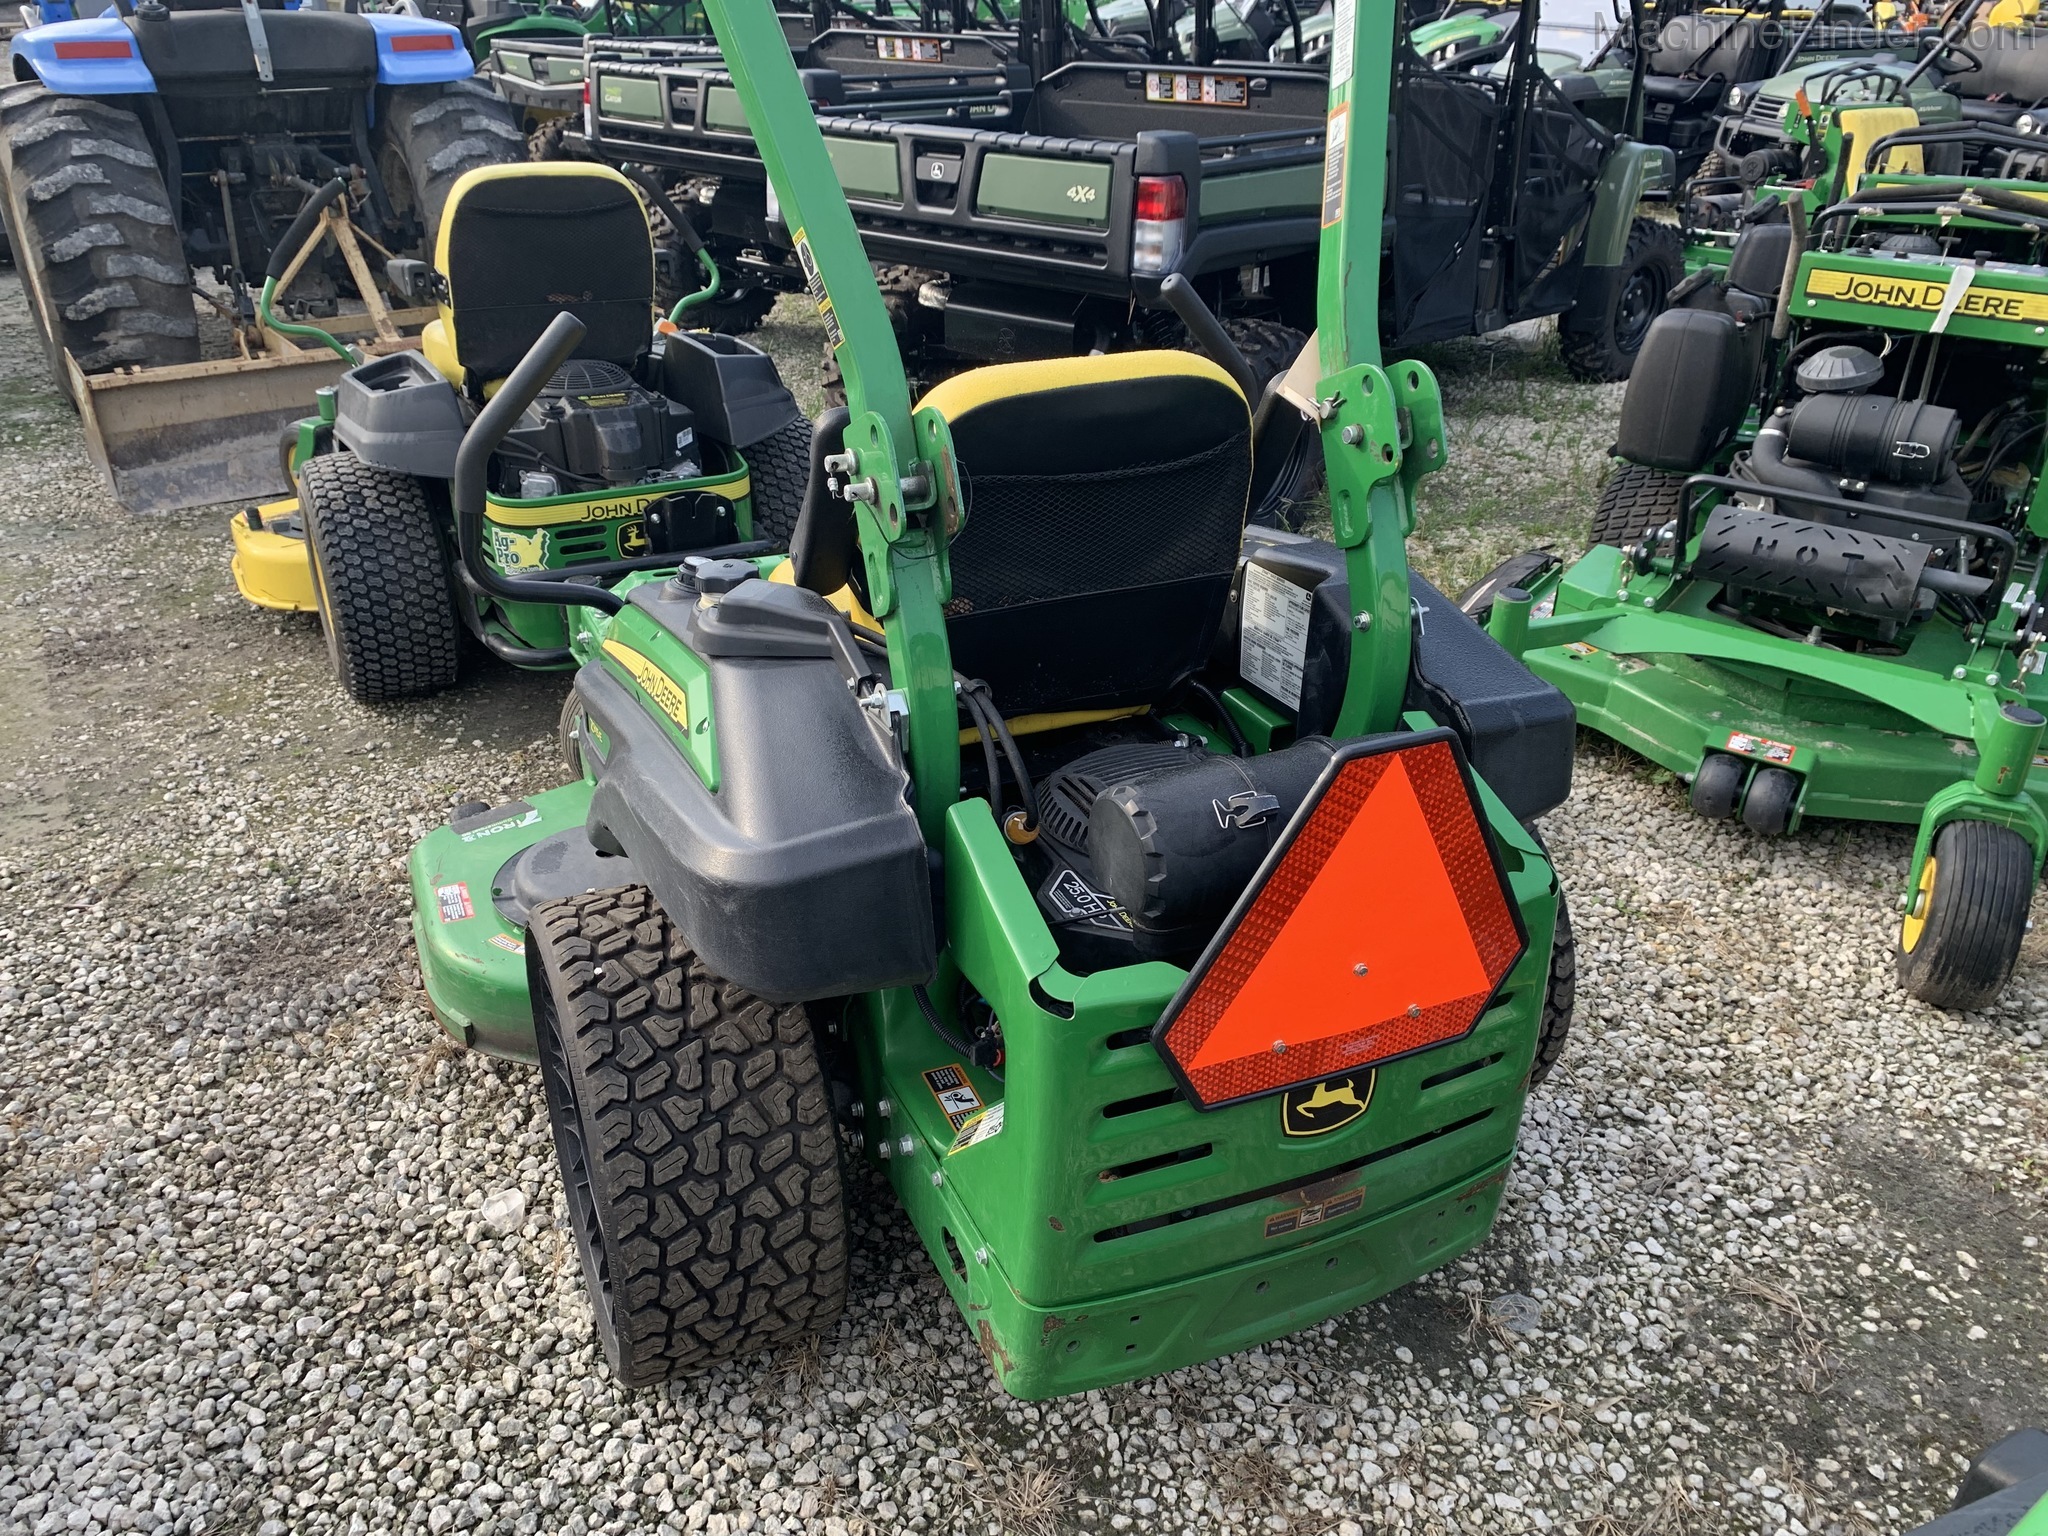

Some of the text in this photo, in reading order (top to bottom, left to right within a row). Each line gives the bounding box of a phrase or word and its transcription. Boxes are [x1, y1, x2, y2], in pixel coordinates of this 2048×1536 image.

[1835, 276, 2025, 316] JOHN DERE
[581, 503, 632, 520] JOHN
[494, 531, 515, 551] Ag-
[497, 547, 520, 565] Pro
[1752, 536, 1865, 575] HOT
[638, 661, 682, 718] JOHN DEERE
[1063, 881, 1092, 903] 25.0
[1118, 911, 1134, 928] DEER
